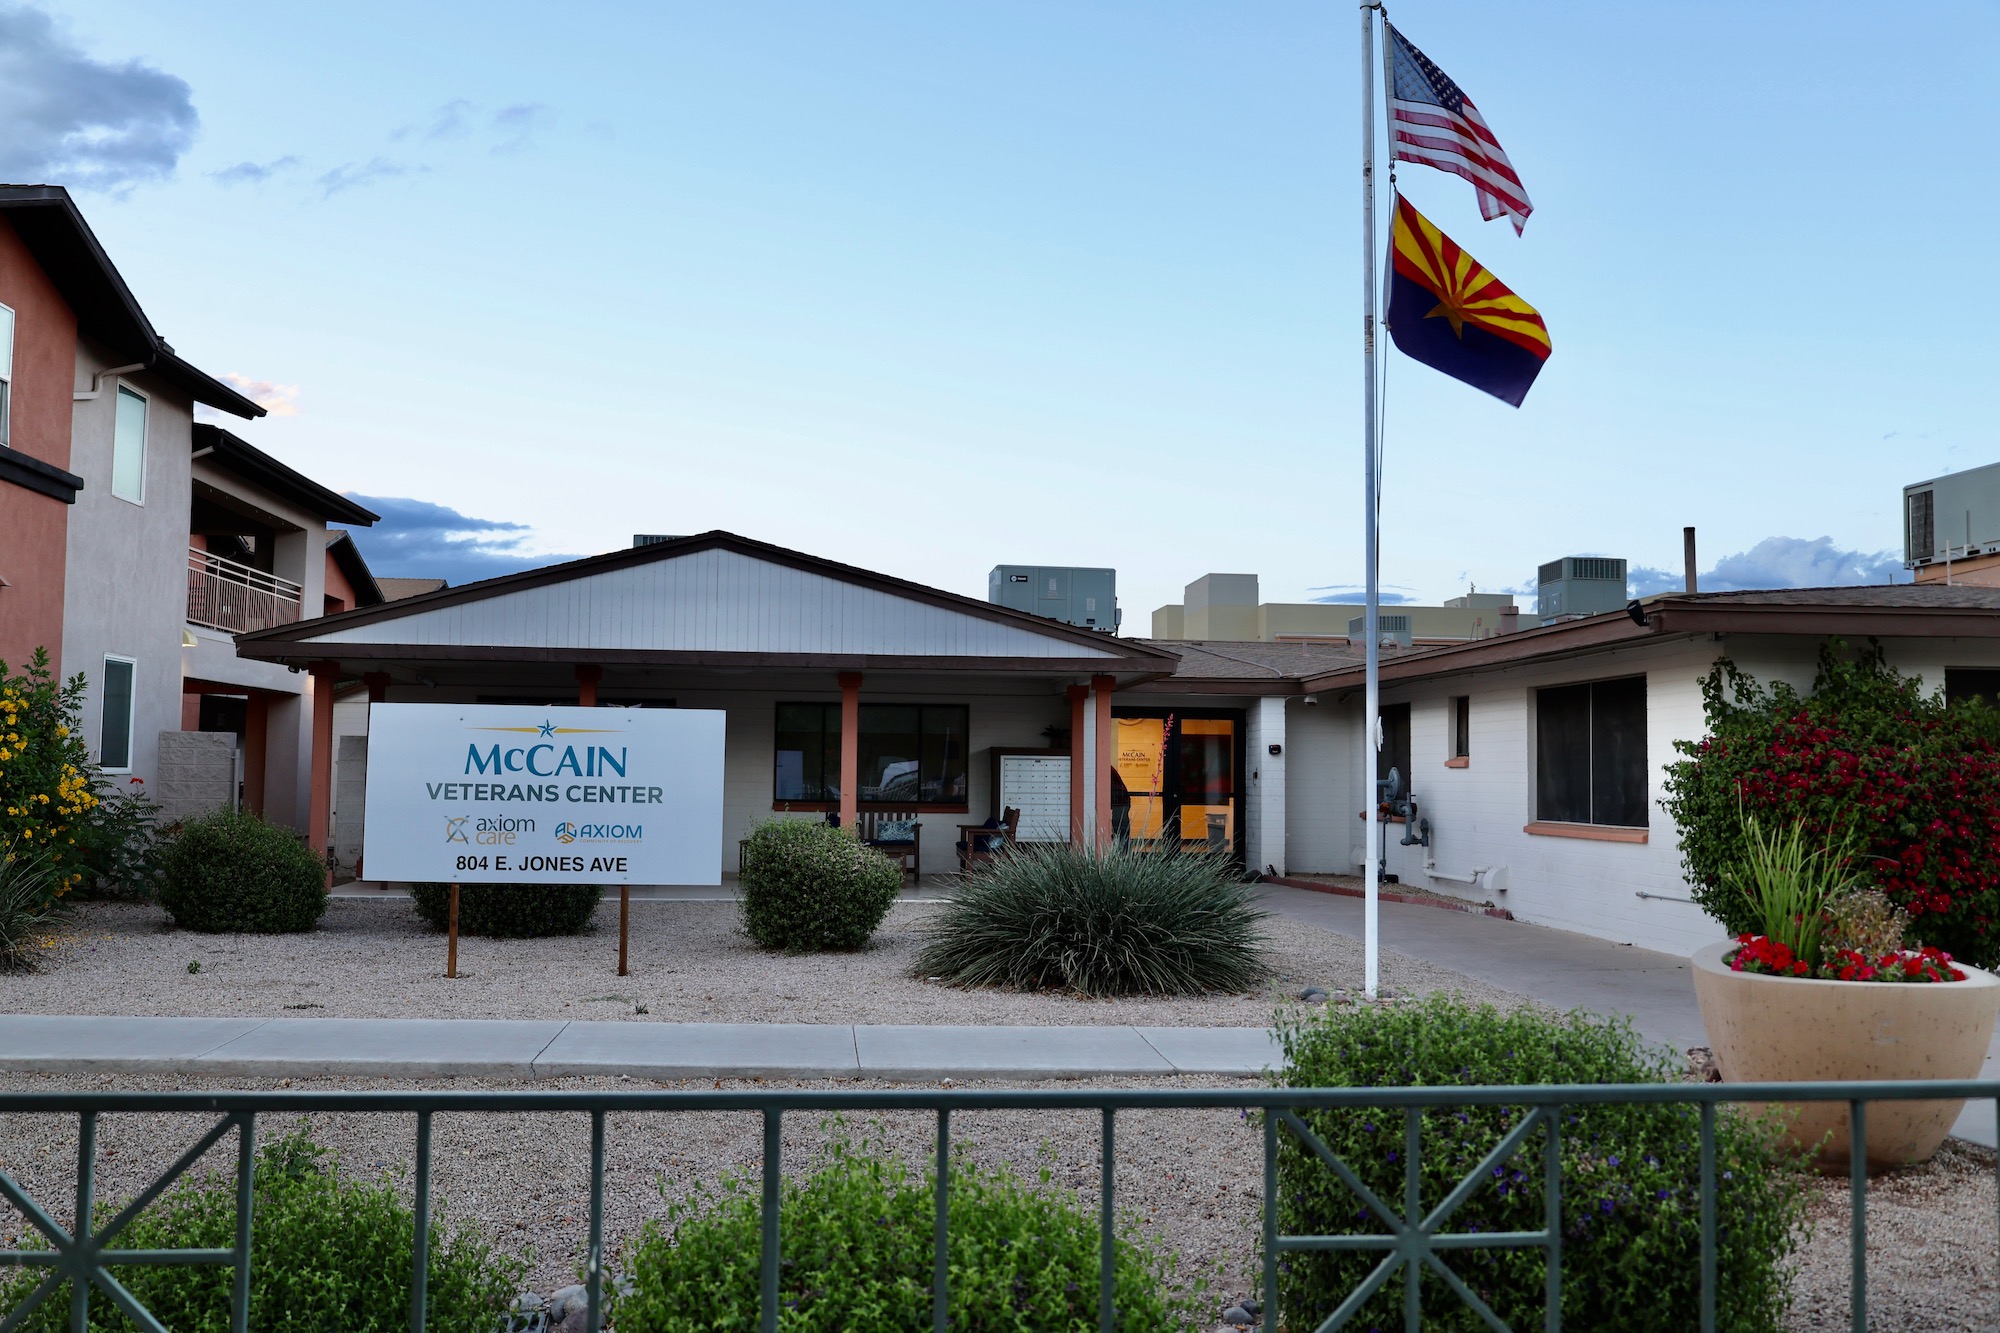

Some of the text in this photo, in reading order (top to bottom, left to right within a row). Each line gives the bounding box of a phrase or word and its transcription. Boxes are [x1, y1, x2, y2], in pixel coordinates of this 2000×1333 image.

[464, 743, 627, 778] McCAIN
[426, 782, 663, 804] VETERANS CENTER
[476, 814, 535, 832] axiom
[580, 824, 642, 838] AXIOM
[475, 831, 516, 845] care
[456, 855, 628, 872] 804 E. JONES AVE
